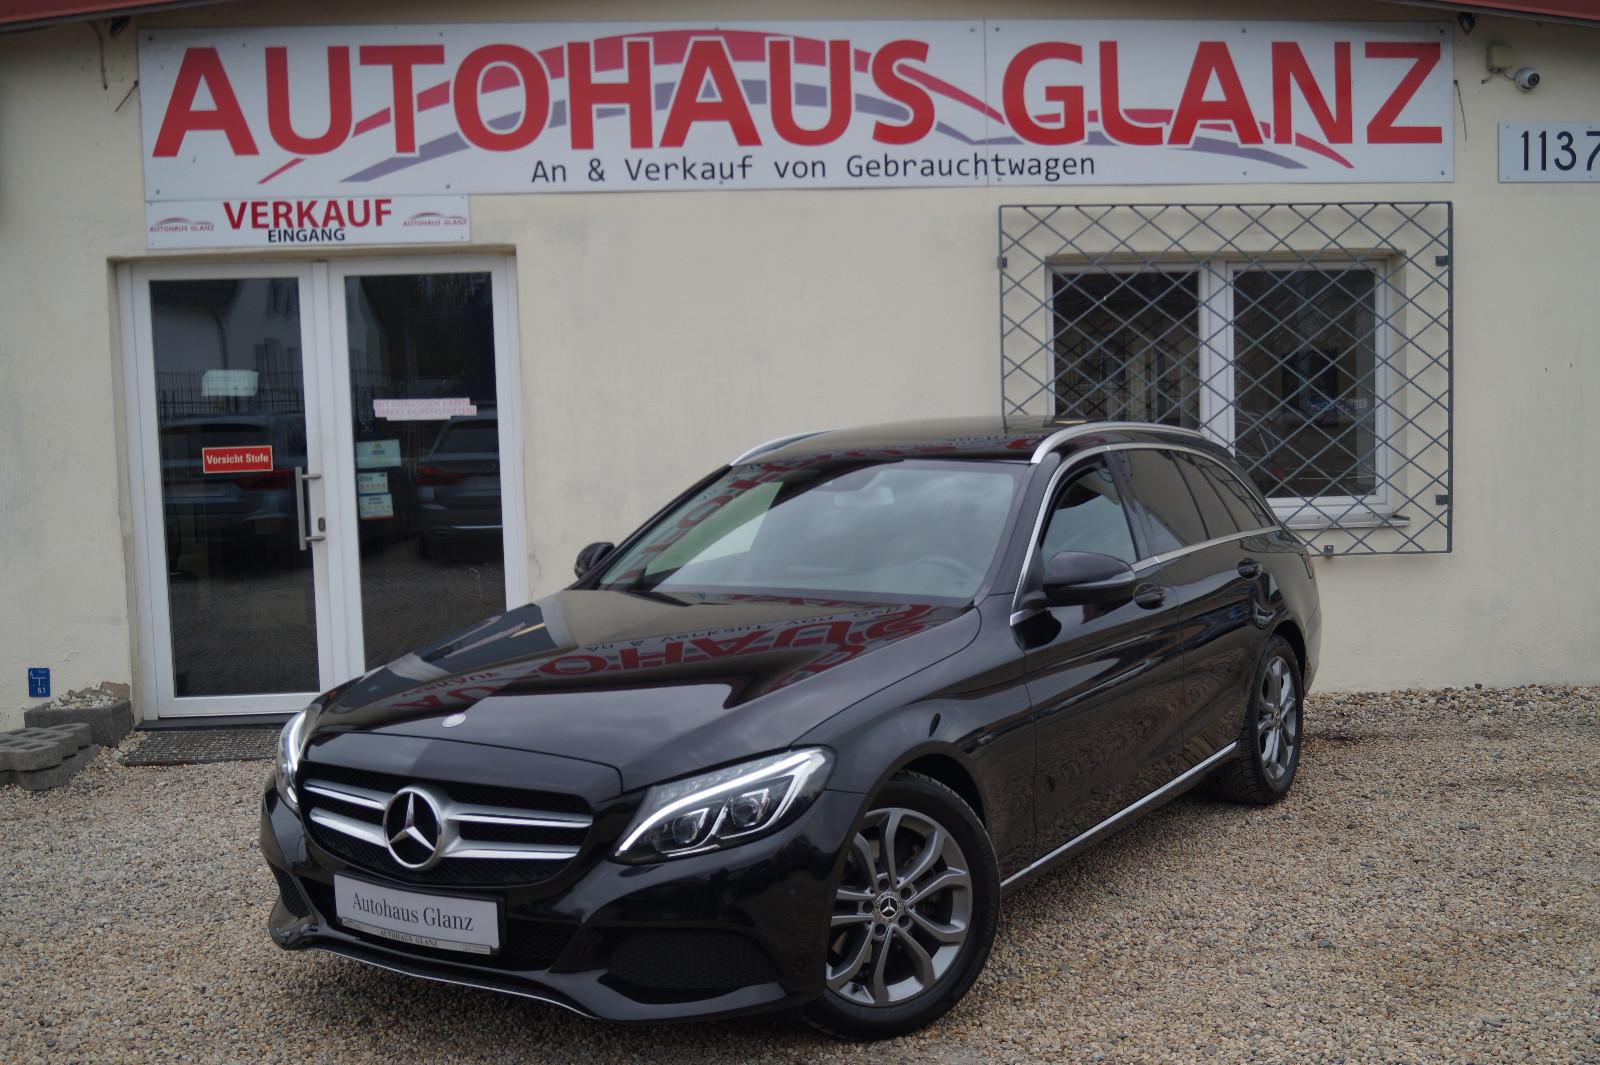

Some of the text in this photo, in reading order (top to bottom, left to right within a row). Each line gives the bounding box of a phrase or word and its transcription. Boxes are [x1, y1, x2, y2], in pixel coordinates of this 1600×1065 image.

[152, 39, 1443, 158] AUTOHAUS GLANZ
[531, 152, 1095, 183] An & Verkauf von Gebrauchtwagen
[149, 224, 216, 233] AUTOHAUS GLANZ
[223, 198, 393, 230] VERKAUF
[267, 228, 346, 243] EINGANG
[206, 452, 269, 465] Vorsicht Stufe
[352, 892, 474, 932] Autohaus Glanz
